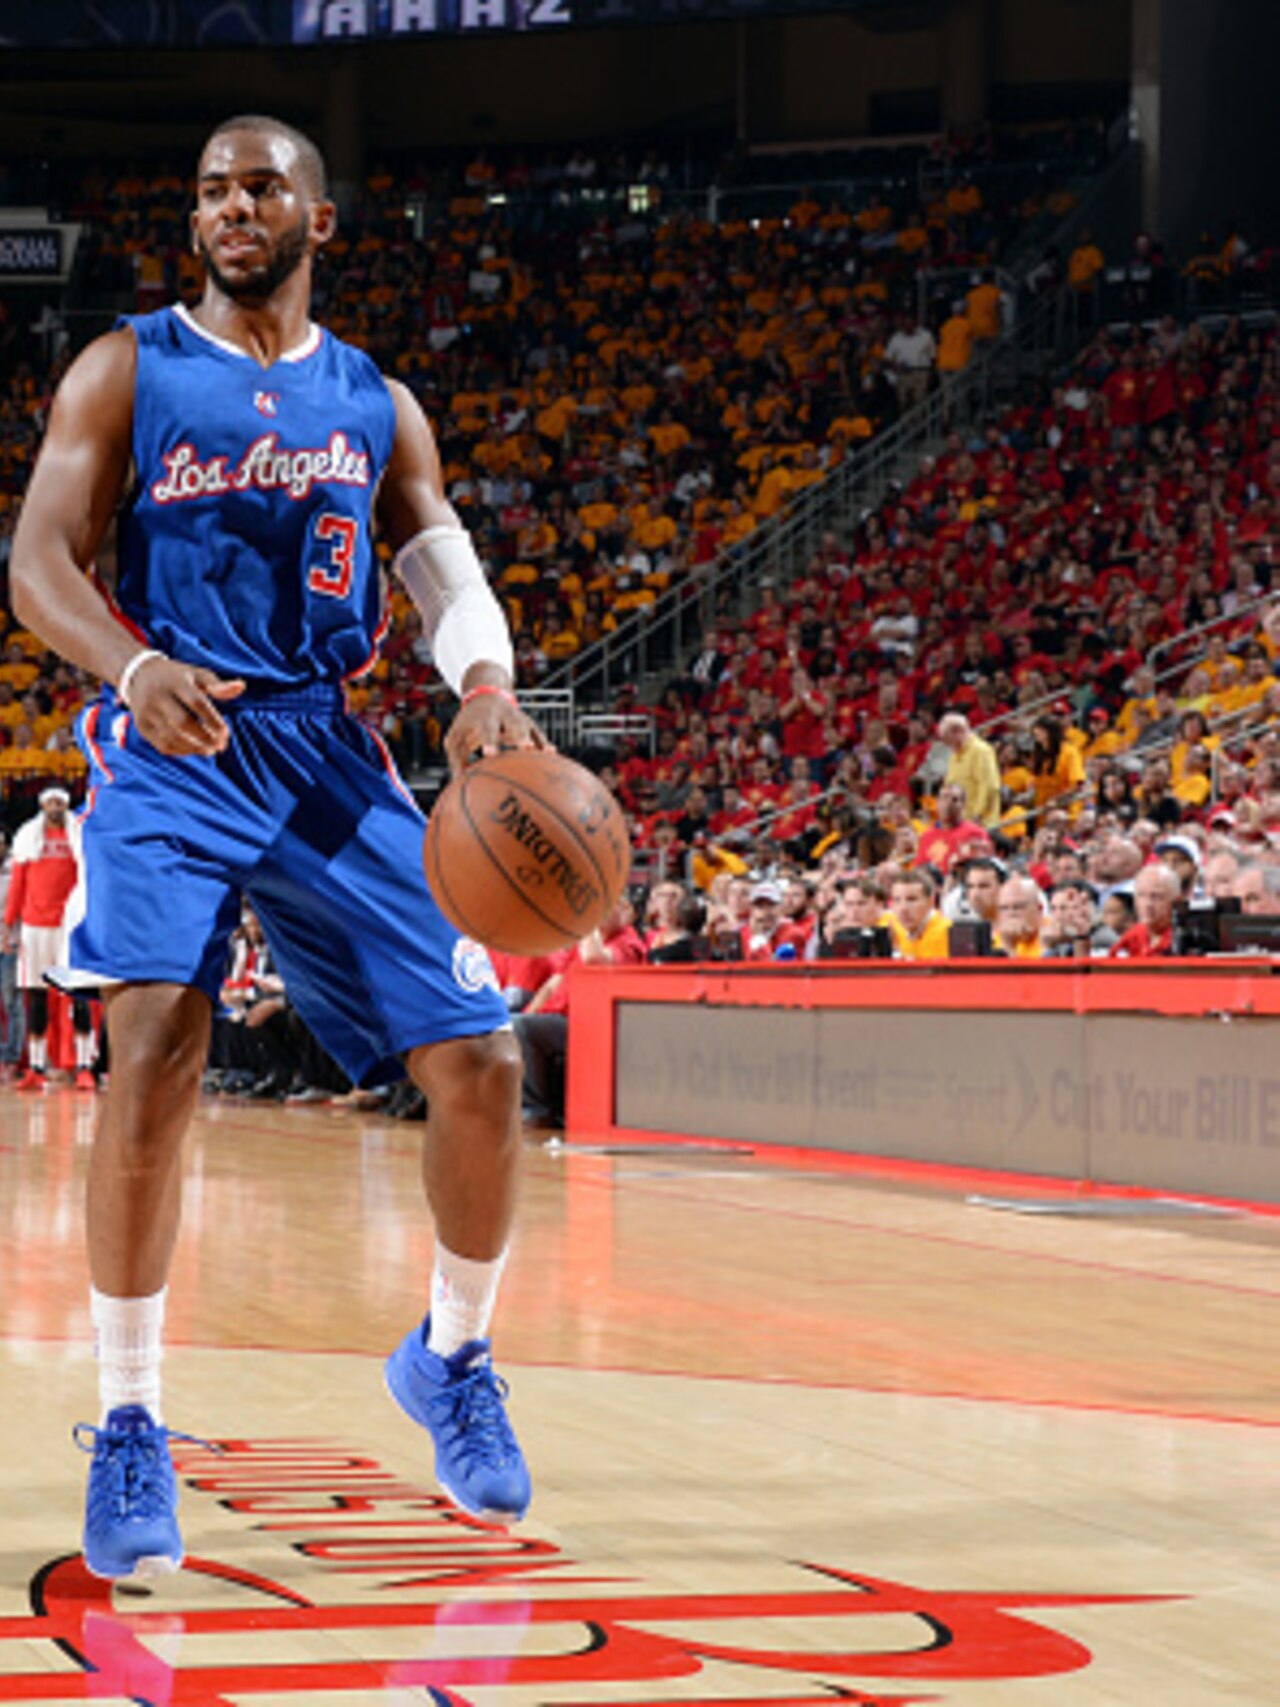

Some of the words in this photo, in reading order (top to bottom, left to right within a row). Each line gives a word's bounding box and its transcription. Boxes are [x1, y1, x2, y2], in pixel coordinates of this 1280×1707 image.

[152, 443, 229, 504] Los
[231, 431, 370, 500] Angeles
[307, 512, 358, 598] 3
[490, 793, 600, 917] SPALDING
[1050, 1066, 1107, 1132] Cut
[1113, 1069, 1190, 1139] Your
[1195, 1074, 1251, 1146] Bill
